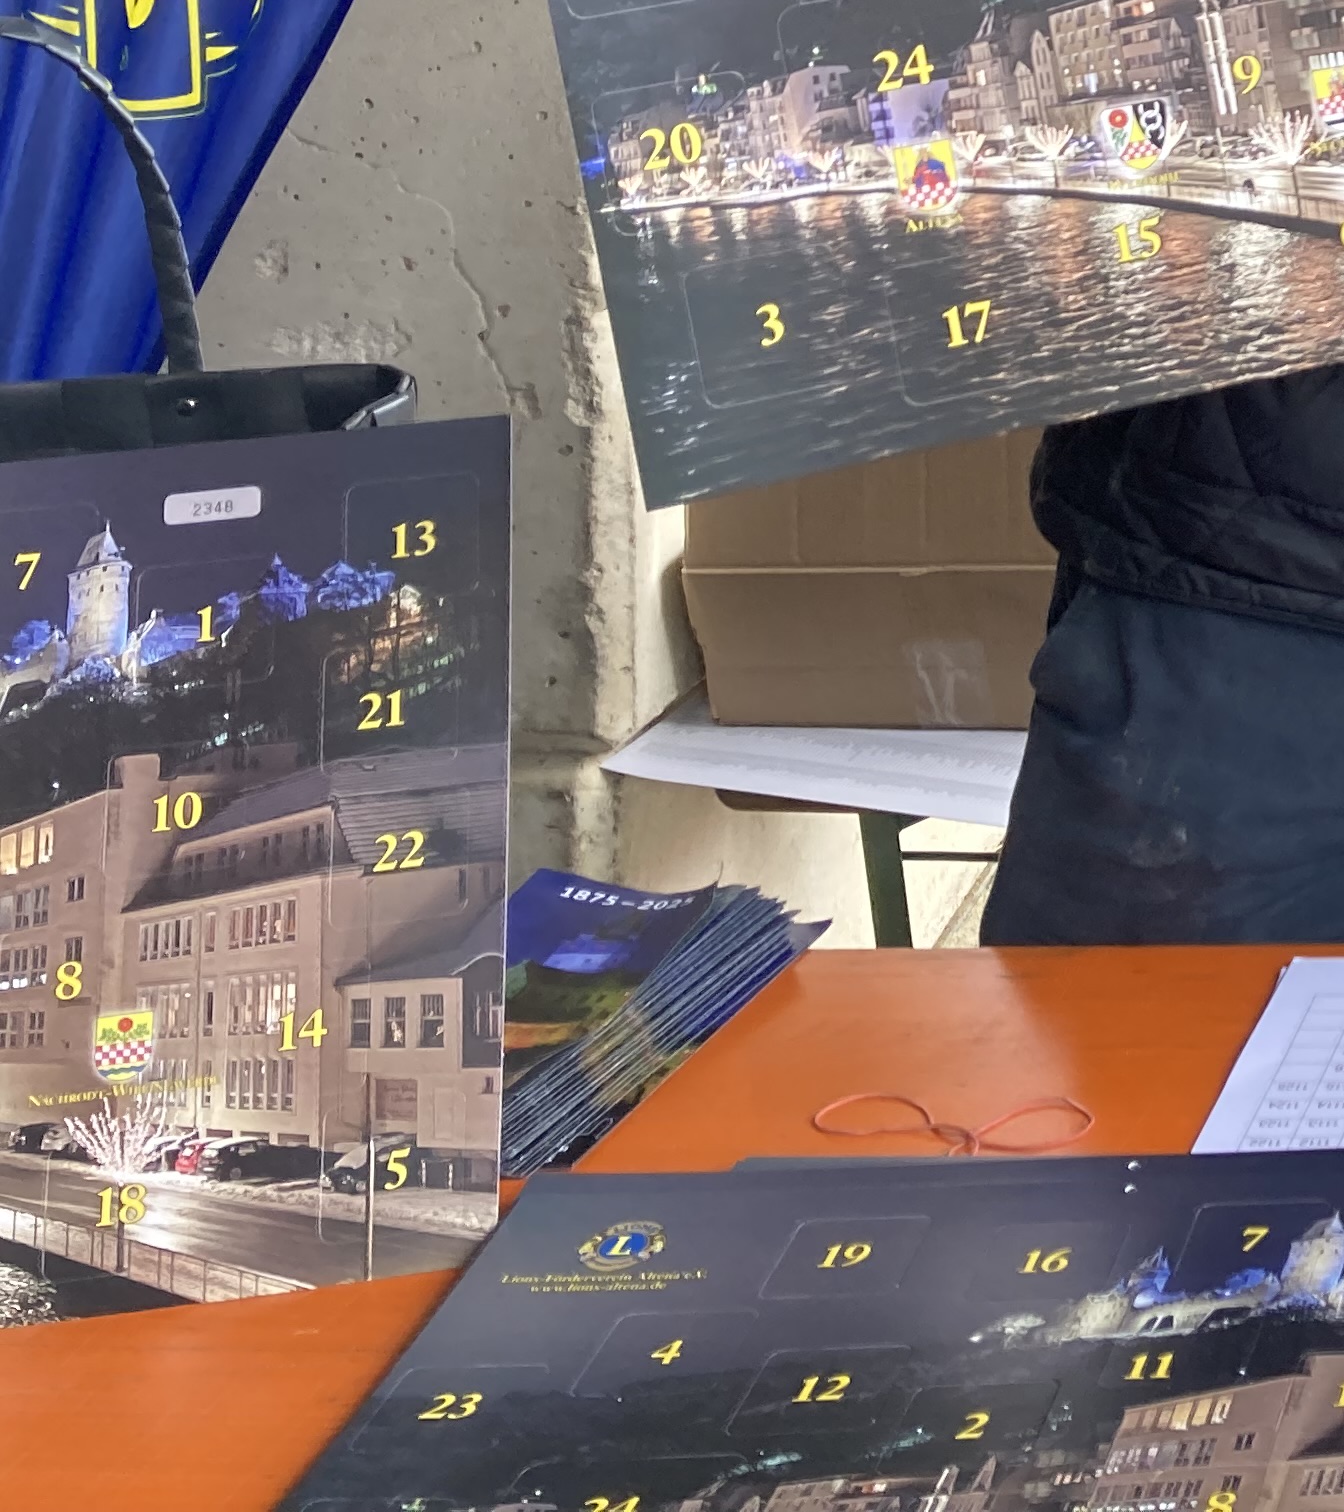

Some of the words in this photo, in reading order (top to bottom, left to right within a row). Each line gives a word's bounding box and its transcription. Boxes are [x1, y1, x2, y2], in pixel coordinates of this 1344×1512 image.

[872, 44, 934, 91] 24
[1233, 54, 1262, 94] 9
[639, 122, 702, 171] 20
[1113, 216, 1162, 263] 15
[755, 303, 785, 348] 3
[942, 299, 992, 350] 17
[192, 500, 234, 517] 2348
[391, 519, 437, 559] 13
[14, 552, 41, 590] 7
[197, 605, 214, 642] 1
[357, 690, 405, 731] 21
[151, 791, 202, 833] 10
[373, 829, 425, 873] 22
[55, 961, 82, 1000] 8
[277, 1008, 327, 1052] 14
[384, 1147, 411, 1190] 5
[96, 1184, 146, 1227] 18
[817, 1242, 871, 1268] 19
[1241, 1226, 1269, 1251] 7
[1017, 1248, 1072, 1273] 16
[650, 1339, 683, 1366] 4
[1124, 1351, 1174, 1380] 11
[417, 1392, 483, 1420] 23
[792, 1374, 851, 1403] 12
[955, 1412, 990, 1439] 2
